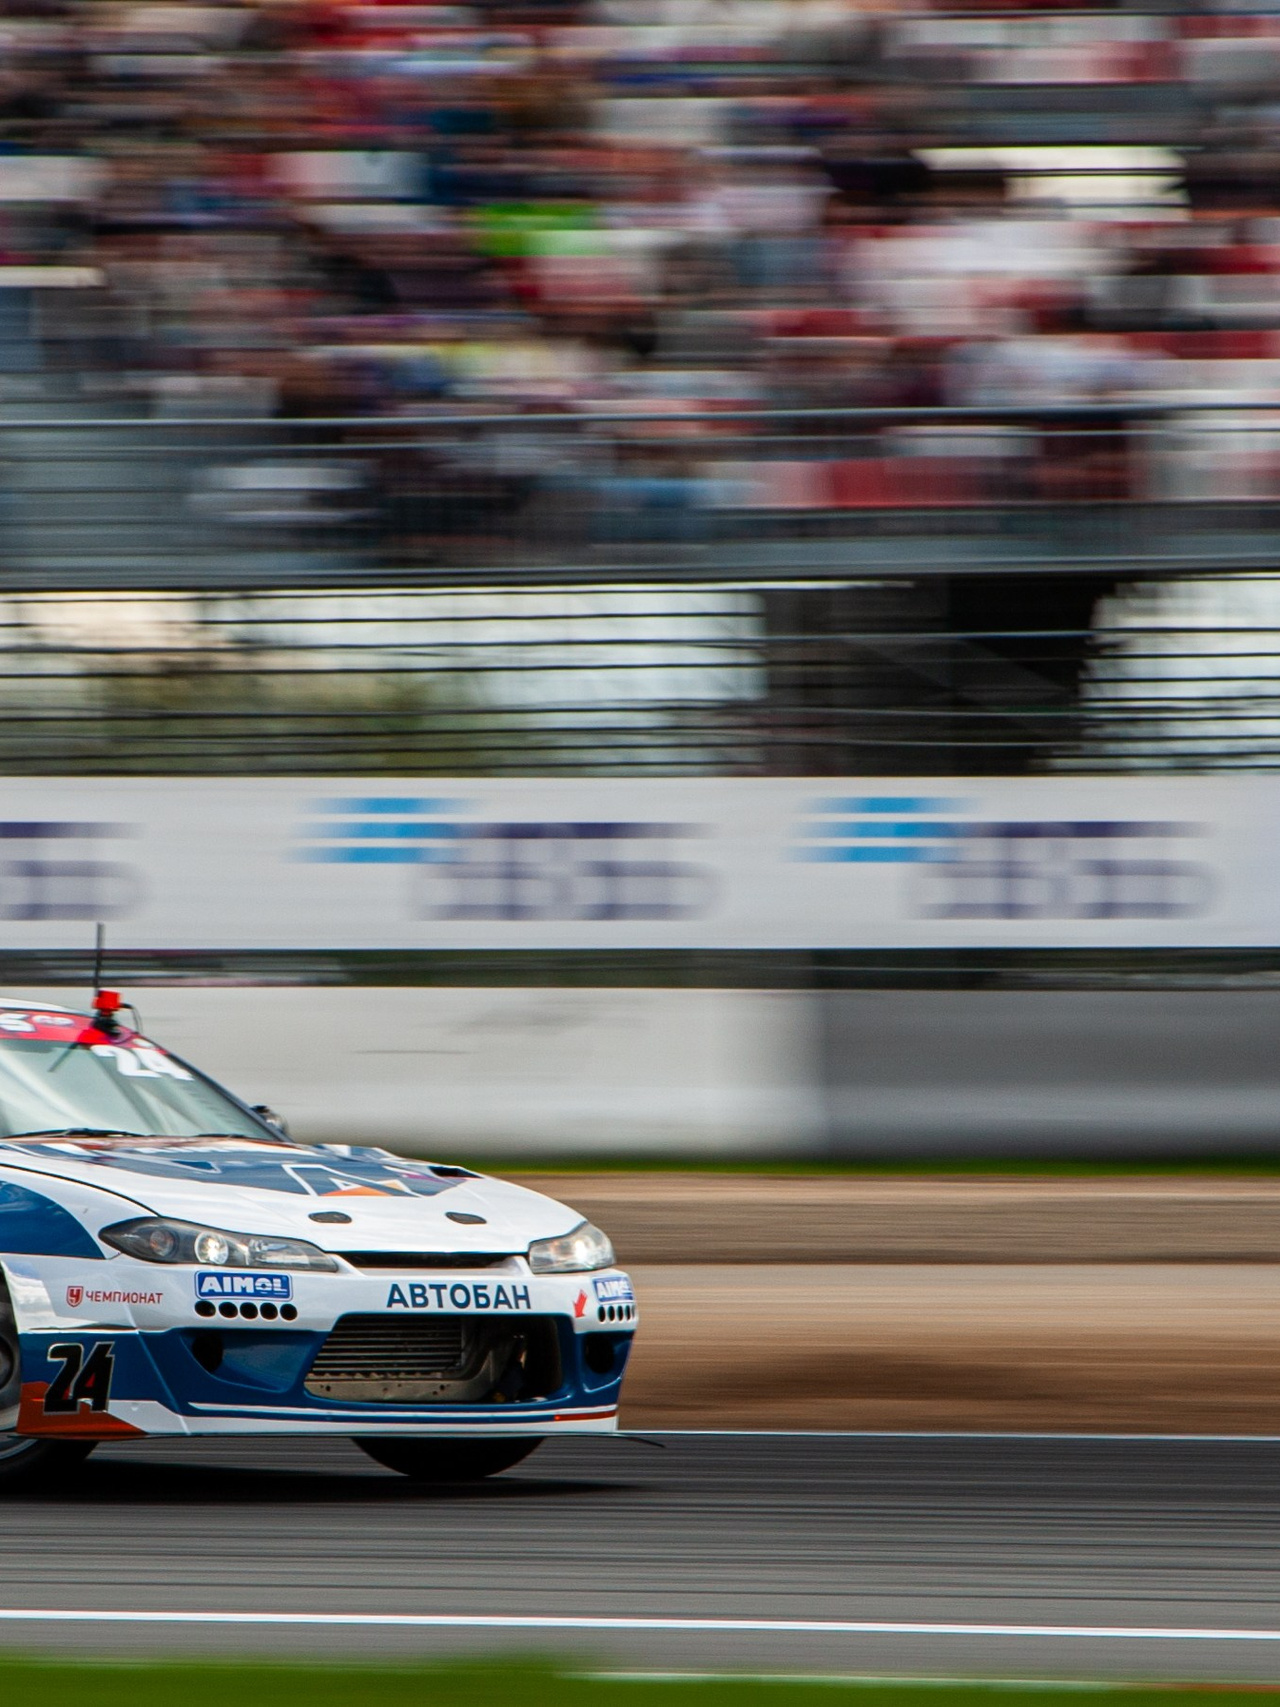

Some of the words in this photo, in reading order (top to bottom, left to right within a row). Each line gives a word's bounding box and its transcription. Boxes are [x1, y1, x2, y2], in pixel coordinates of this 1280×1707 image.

[90, 1044, 195, 1081] 24
[85, 1290, 163, 1304] ЧЕМПИОНАТ
[200, 1276, 288, 1295] AIMOL
[386, 1283, 531, 1310] АВТОБАН
[43, 1341, 115, 1416] 24
